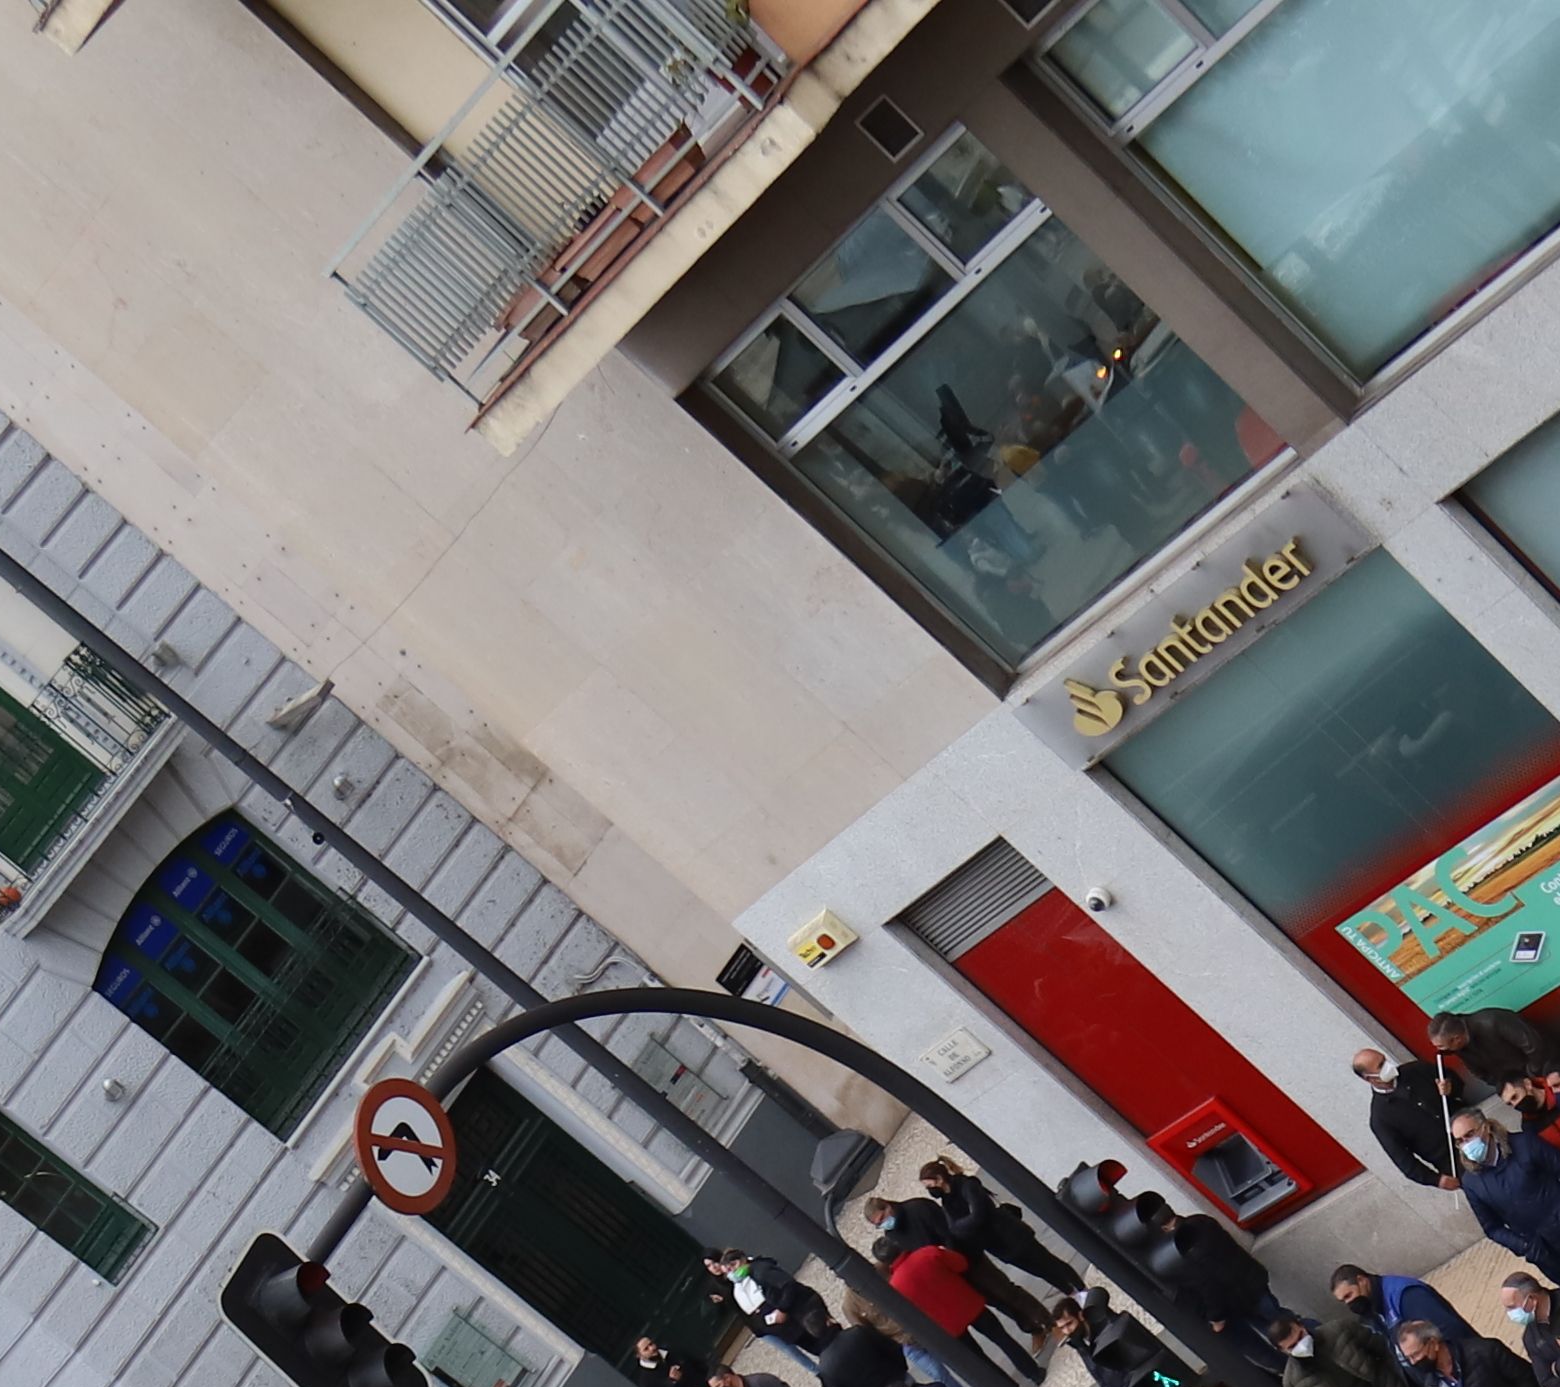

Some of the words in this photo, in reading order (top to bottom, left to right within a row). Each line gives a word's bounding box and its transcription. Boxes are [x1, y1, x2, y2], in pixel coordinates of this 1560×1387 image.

[1109, 537, 1312, 705] Santander
[1344, 846, 1525, 968] PAC
[1354, 936, 1403, 980] ANTICIPA
[938, 1039, 959, 1057] CALLE
